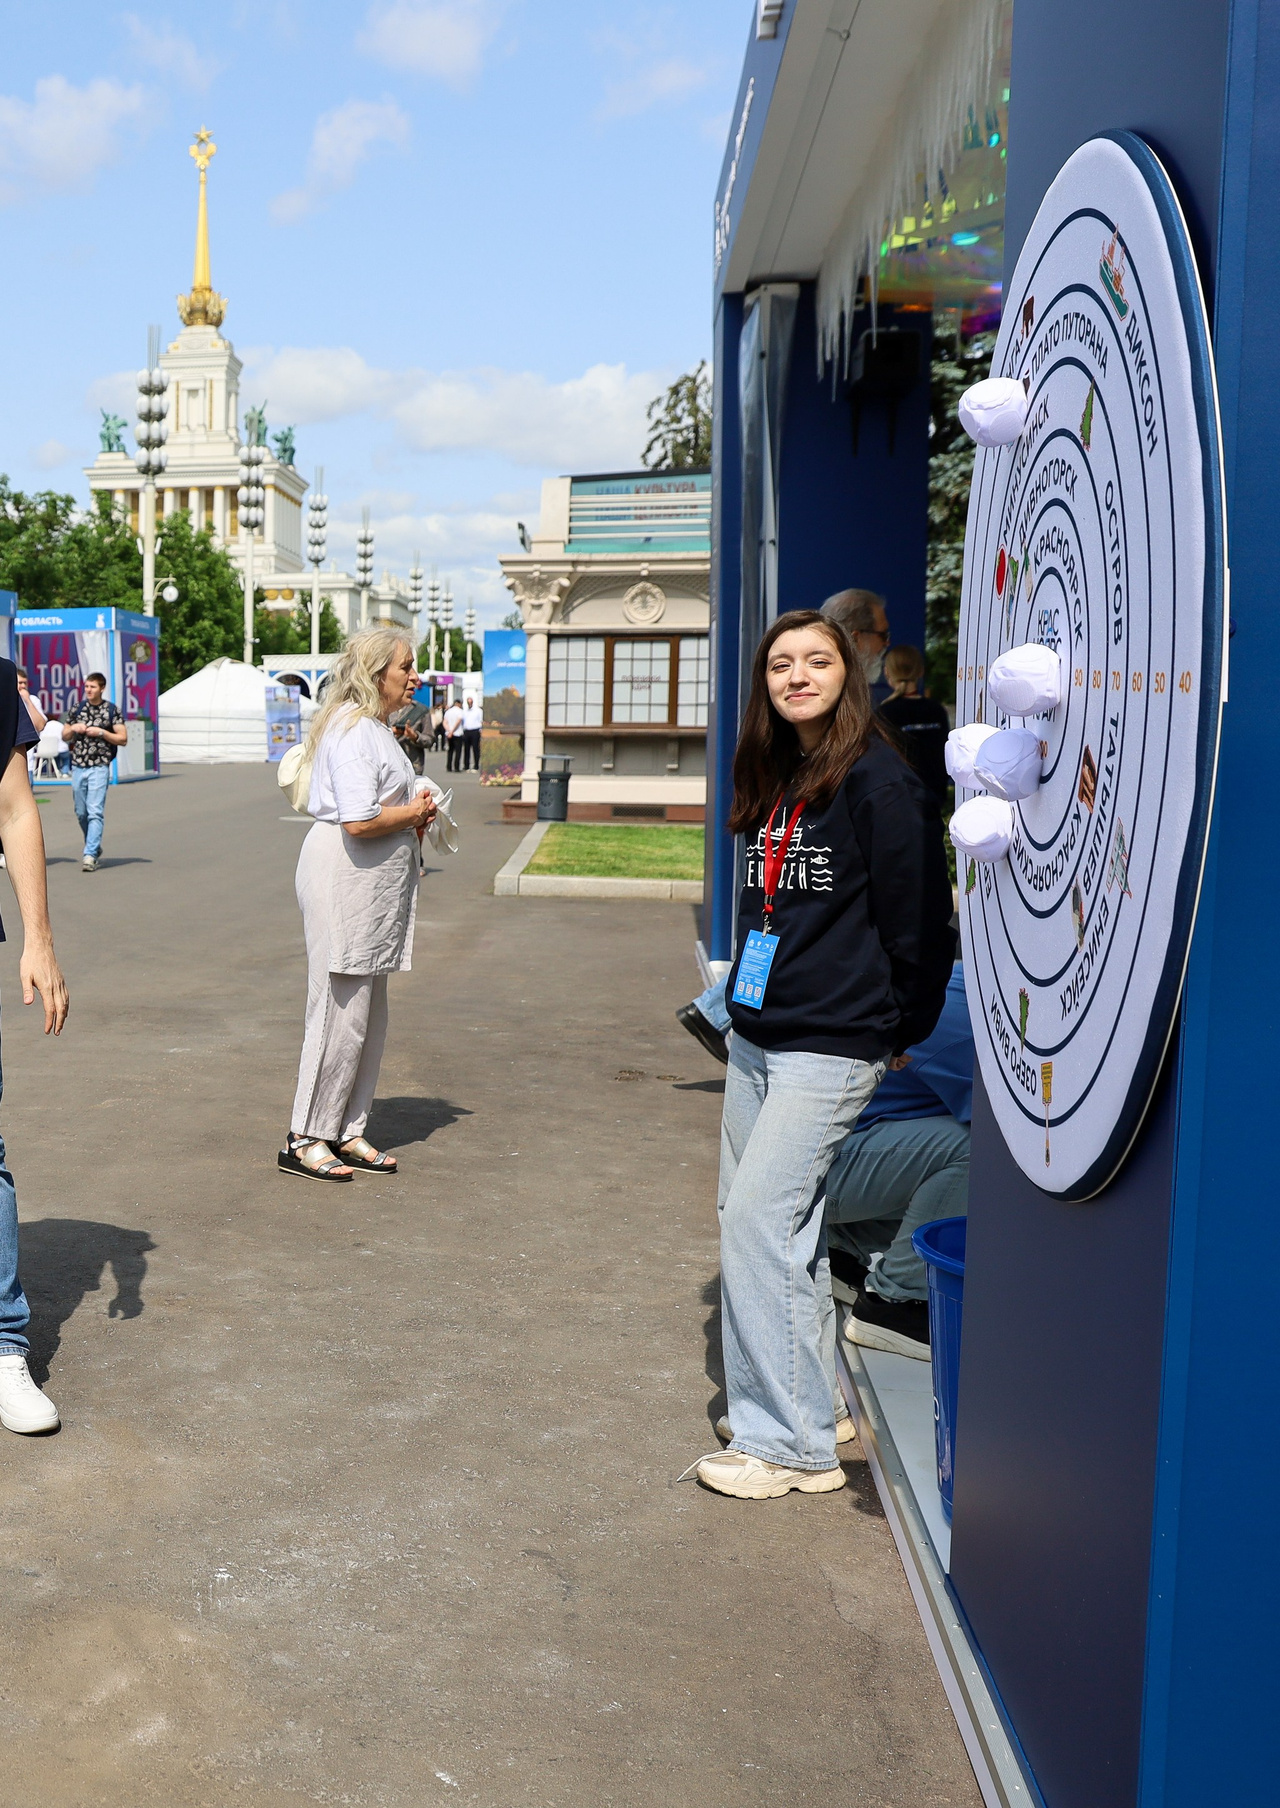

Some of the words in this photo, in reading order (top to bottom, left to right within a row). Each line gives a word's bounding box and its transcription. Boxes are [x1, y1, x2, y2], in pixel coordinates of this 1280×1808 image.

[1031, 318, 1061, 381] ПЛАТО
[1061, 311, 1109, 379] ПУТОРАНА
[1124, 309, 1158, 458] ДИКСОН
[1003, 393, 1050, 546] МИНУСИНСК
[1019, 457, 1078, 555] ДИВНОГОРСК
[1033, 525, 1084, 650] КРАСНОЯРСК
[1105, 480, 1123, 646] ОСТРОВ
[21, 616, 63, 627] ОБЛАСТЬ
[1037, 608, 1060, 637] КРАС
[1074, 668, 1083, 688] 90
[1092, 670, 1102, 689] 80
[1111, 671, 1121, 691] 70
[1131, 671, 1143, 693] 60
[1154, 672, 1166, 694] 50
[1178, 671, 1192, 694] 40
[1084, 712, 1120, 896] ТАТЫШЕВ
[747, 857, 807, 890] ЕНСЕЙ
[1060, 893, 1109, 1021] ЕНИСЕЙСК
[991, 993, 1011, 1063] ВИВИ
[1010, 1046, 1037, 1096] ОЗЕРО
